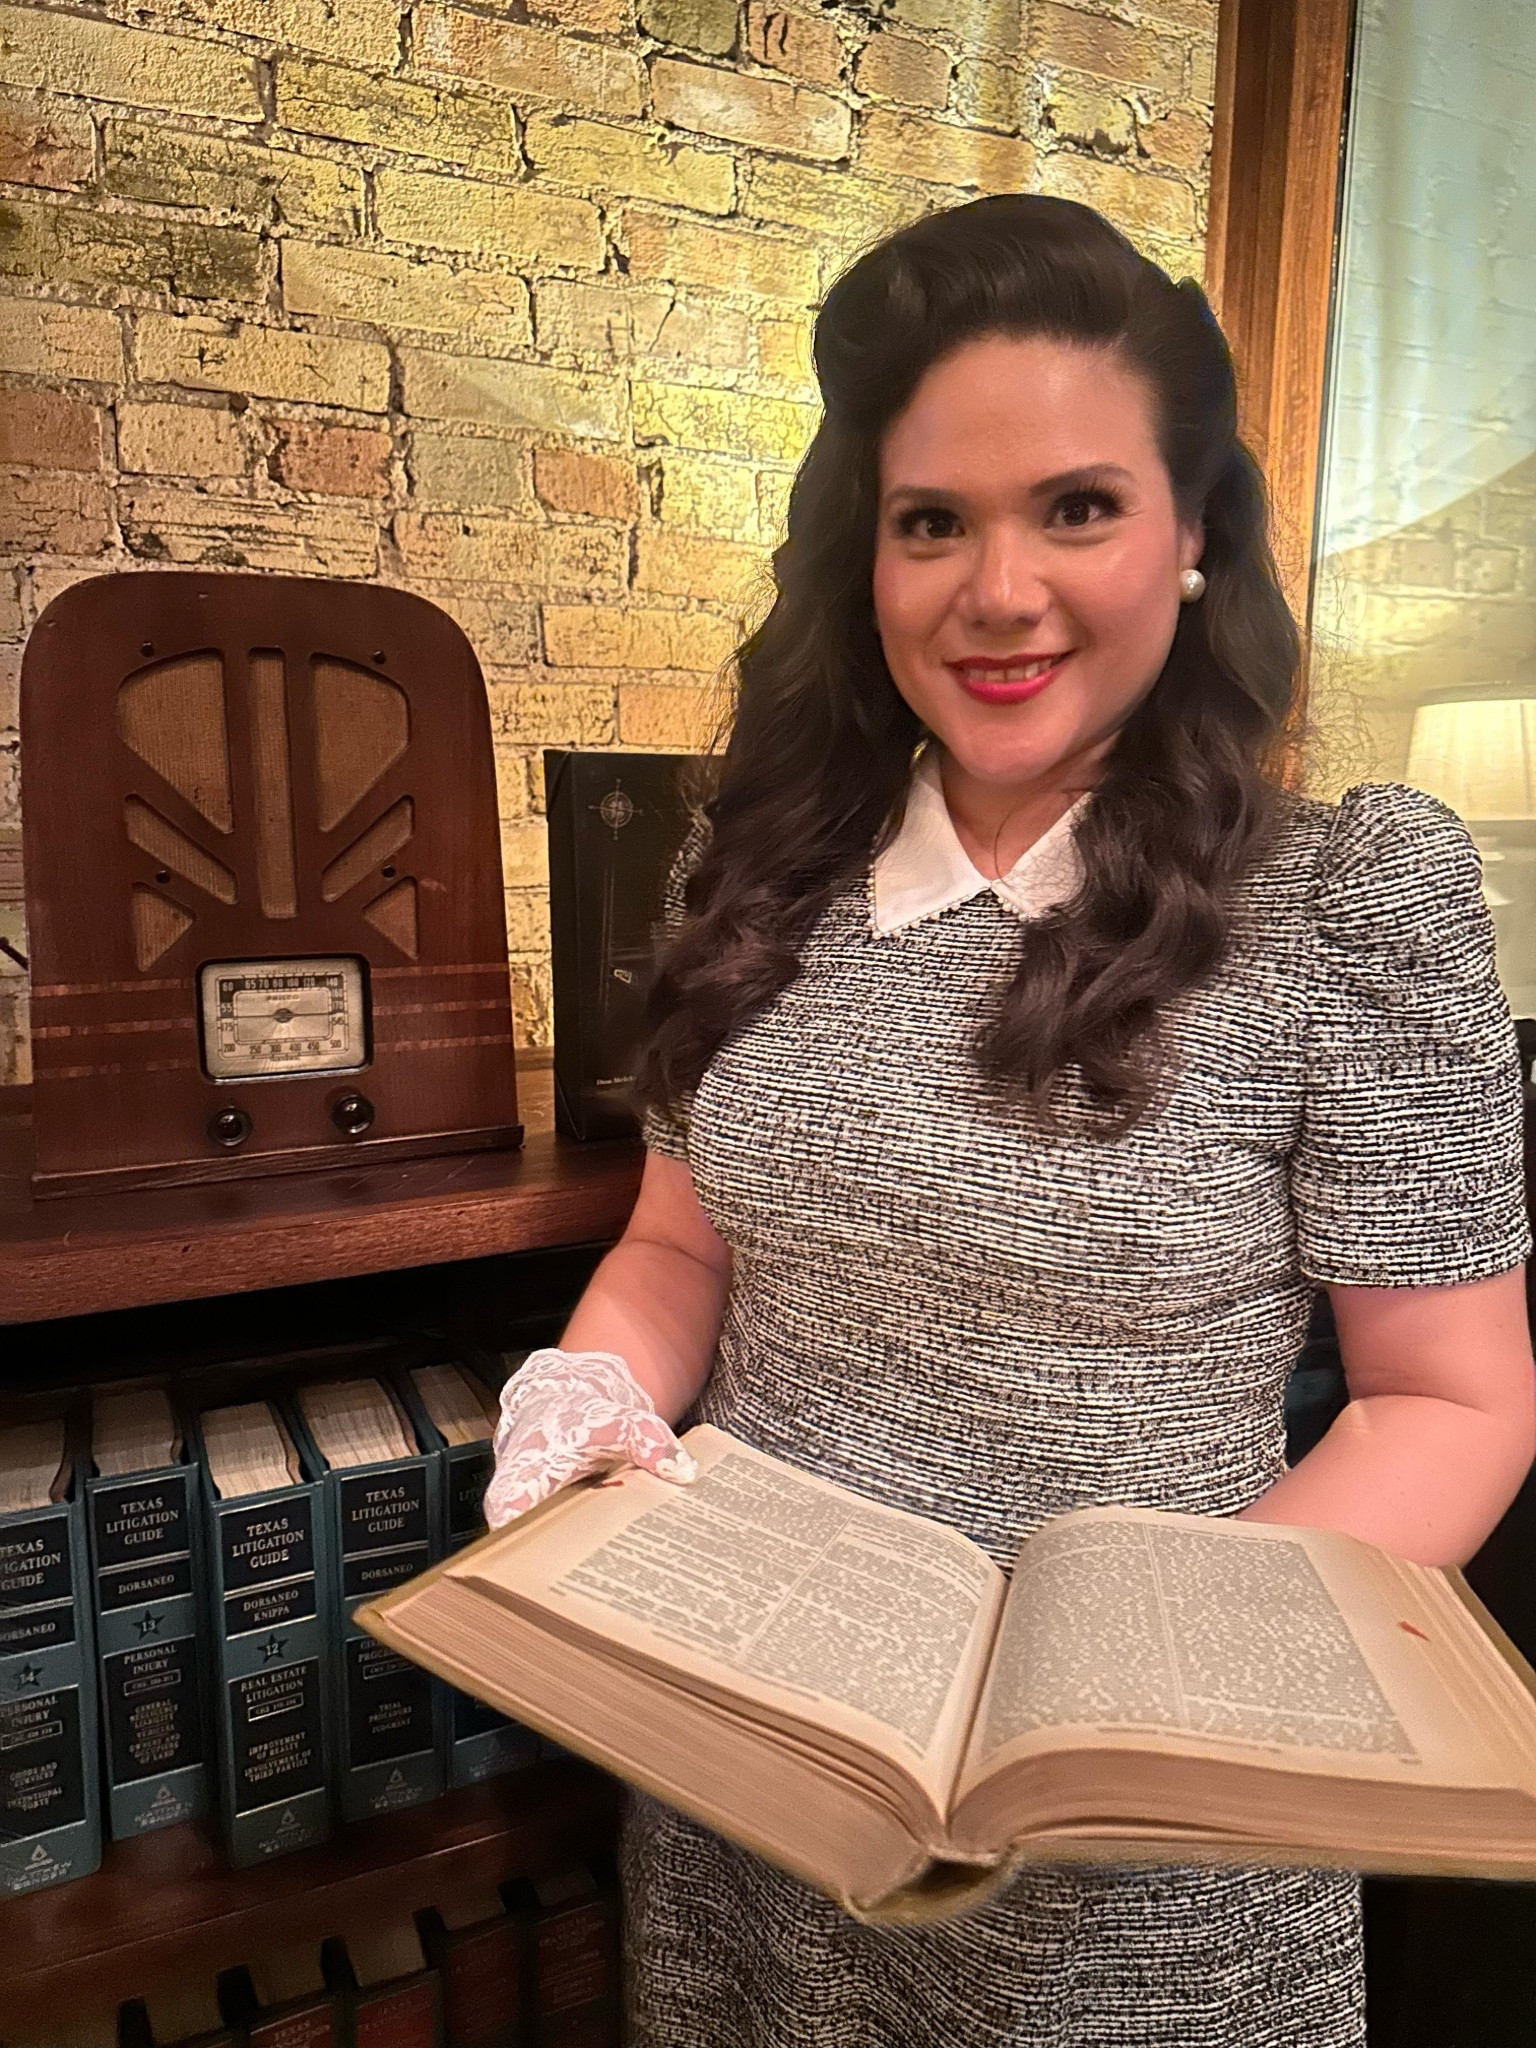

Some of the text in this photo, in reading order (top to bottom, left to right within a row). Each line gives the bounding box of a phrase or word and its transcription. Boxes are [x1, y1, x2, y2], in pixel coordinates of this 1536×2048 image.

[223, 976, 338, 991] 60 65 70 80 100 120 140
[222, 1003, 232, 1012] 55
[250, 1044, 262, 1054] 250
[289, 1042, 301, 1051] 400
[308, 1042, 319, 1050] 450
[366, 1486, 405, 1503] TEXAS
[121, 1496, 163, 1514] TEXAS
[352, 1499, 420, 1521] LITIGATION
[106, 1510, 179, 1533] LITIGATION
[247, 1518, 288, 1537] TEXAS
[368, 1518, 405, 1533] GUIDE
[124, 1528, 164, 1544] GUIDE
[232, 1530, 304, 1557] LITIGATION
[0, 1552, 61, 1574] IGATION
[250, 1549, 290, 1568] GUIDE
[362, 1563, 413, 1580] DORSANEO
[2, 1572, 44, 1590] GUIDE
[118, 1574, 174, 1594] DORSANEO
[244, 1590, 298, 1612] DORSANEO
[254, 1606, 290, 1622] KNIPPA
[142, 1620, 156, 1632] 13
[124, 1644, 177, 1664] PERSONAL
[266, 1644, 278, 1656] 12
[133, 1658, 168, 1675] INJURY
[20, 1672, 34, 1684] 14
[241, 1666, 306, 1692] REAL ESTATE
[246, 1678, 304, 1704] LITIGATION
[12, 1710, 50, 1728] INJURY
[248, 1732, 306, 1756] IMPROVEMENT
[244, 1753, 300, 1776] INVOLVEMENT
